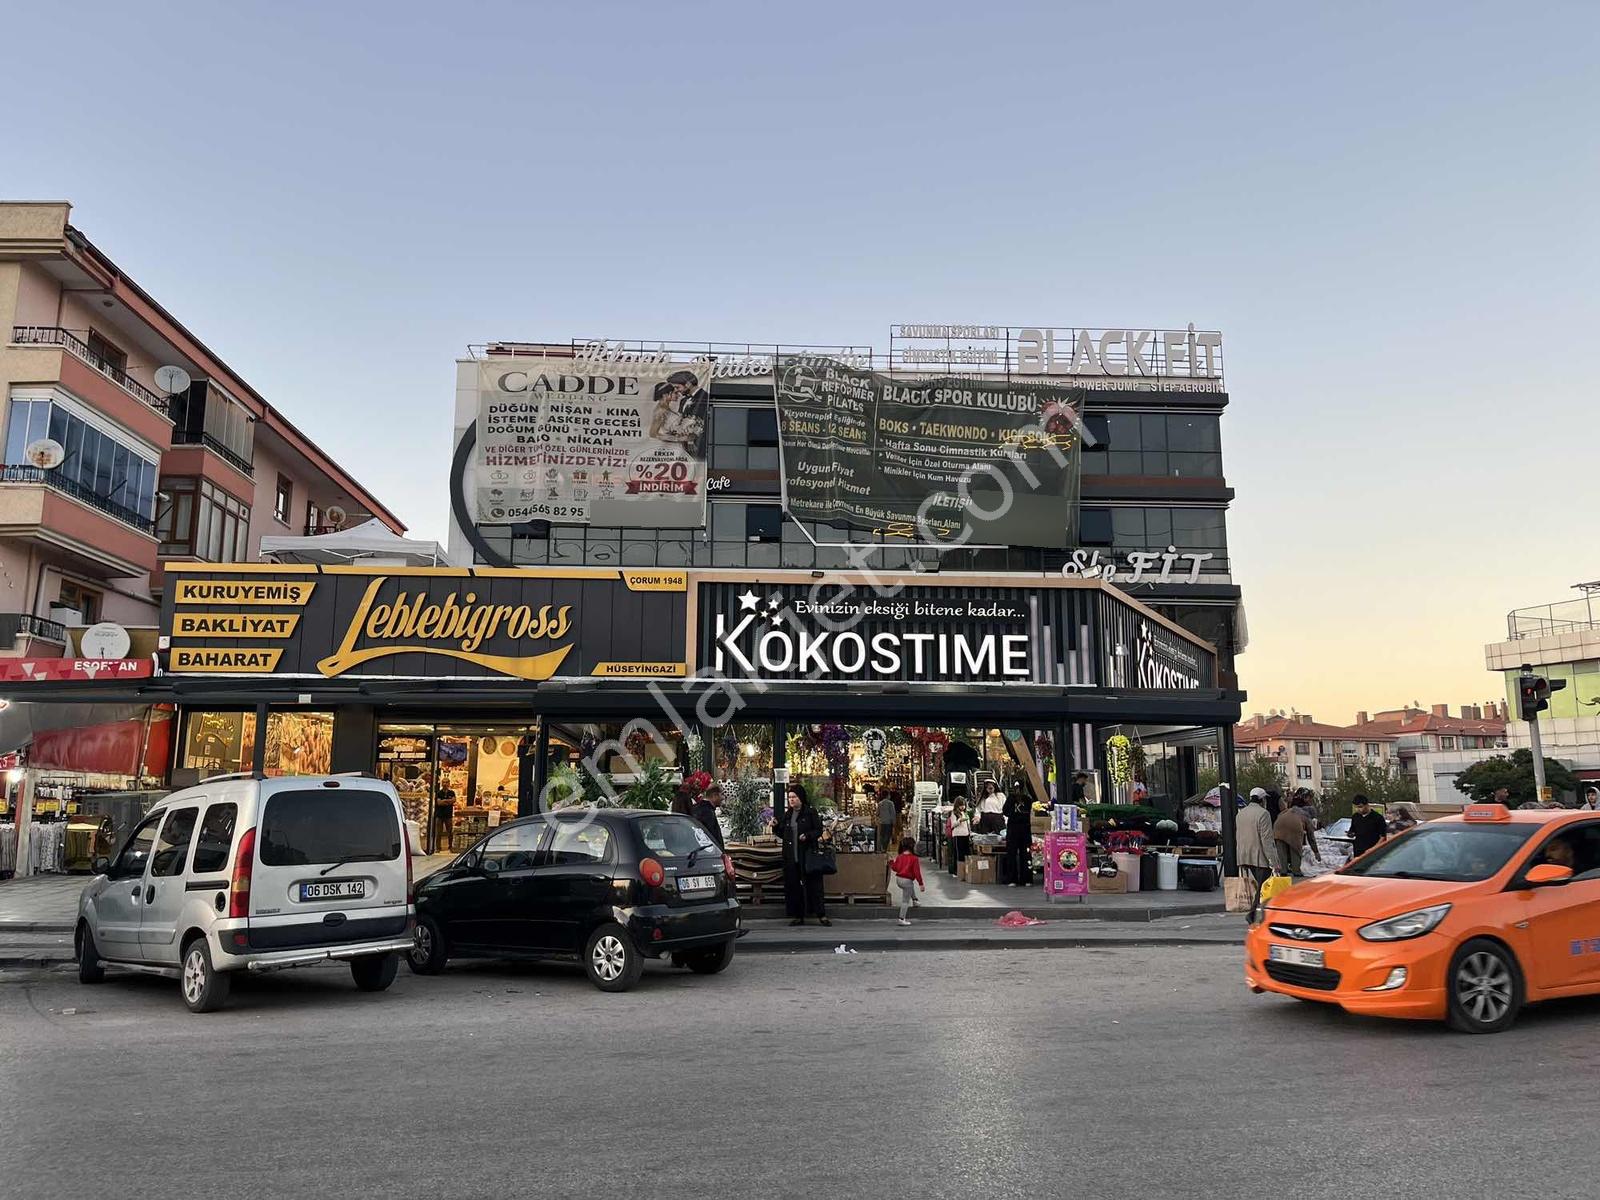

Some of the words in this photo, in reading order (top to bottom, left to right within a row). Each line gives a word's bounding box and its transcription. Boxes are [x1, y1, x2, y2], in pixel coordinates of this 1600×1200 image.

[899, 325, 948, 338] SAVUNMA
[1017, 329, 1151, 375] BLACK
[1165, 322, 1222, 377] FİT
[498, 371, 640, 396] CADDE
[825, 367, 871, 390] BLACK
[821, 380, 875, 402] REFORMER
[1072, 381, 1109, 391] POWER
[1110, 381, 1139, 392] JUMP
[882, 384, 931, 404] BLACK
[934, 387, 973, 406] SPOR
[976, 391, 1038, 413] KULÜBÜ
[489, 404, 539, 414] DÜĞÜN
[550, 403, 592, 416] NİŞAN
[606, 407, 640, 417] KINA
[488, 413, 537, 424] İSTEME
[547, 415, 590, 426] ASKER
[594, 417, 641, 428] GECESİ
[488, 424, 535, 434] DOĞUM
[583, 427, 642, 438] TOPLANTI
[788, 420, 820, 434] SEANS
[838, 426, 867, 441] SEANS
[879, 418, 909, 434] BOKS
[919, 422, 988, 441] TAEKWONDO
[567, 435, 613, 446] NİKAH
[885, 438, 911, 451] Hafta
[913, 442, 937, 453] Sonu
[939, 445, 987, 458] Cimnastik
[485, 446, 498, 454] VE
[500, 444, 526, 454] DİĞER
[545, 444, 567, 453] ÖZEL
[797, 461, 831, 475] Uygun
[831, 461, 855, 477] Fiyat
[924, 457, 940, 468] Özel
[942, 460, 970, 470] Oturma
[636, 462, 688, 481] %20
[884, 466, 912, 477] Minikler
[927, 473, 944, 481] Kum
[639, 480, 684, 492] İNDİRİM
[706, 475, 731, 490] Cafe
[838, 477, 871, 496] Hizmet
[532, 504, 550, 515] 565
[553, 506, 567, 516] 82
[570, 507, 584, 517] 95
[855, 505, 864, 514] En
[865, 507, 885, 519] Büyük
[1125, 545, 1213, 584] FİT
[629, 576, 661, 586] ÇORUM
[663, 576, 683, 585] 1948
[183, 582, 301, 603] KURUYEMİŞ
[795, 600, 861, 615] Evinizin
[863, 601, 910, 620] eksiği
[914, 601, 964, 617] bitene
[967, 601, 1026, 618] kadar...
[181, 616, 289, 633] BAKLİYAT
[317, 577, 573, 664] Leblebigross
[715, 613, 1030, 675] KOKOSTIME
[74, 661, 137, 671] ESOFAN
[178, 652, 273, 667] BAHARAT
[605, 663, 676, 674] HÜSEYİNGAZİ
[307, 884, 320, 896] 06
[323, 883, 342, 895] DSK
[347, 882, 363, 894] 142
